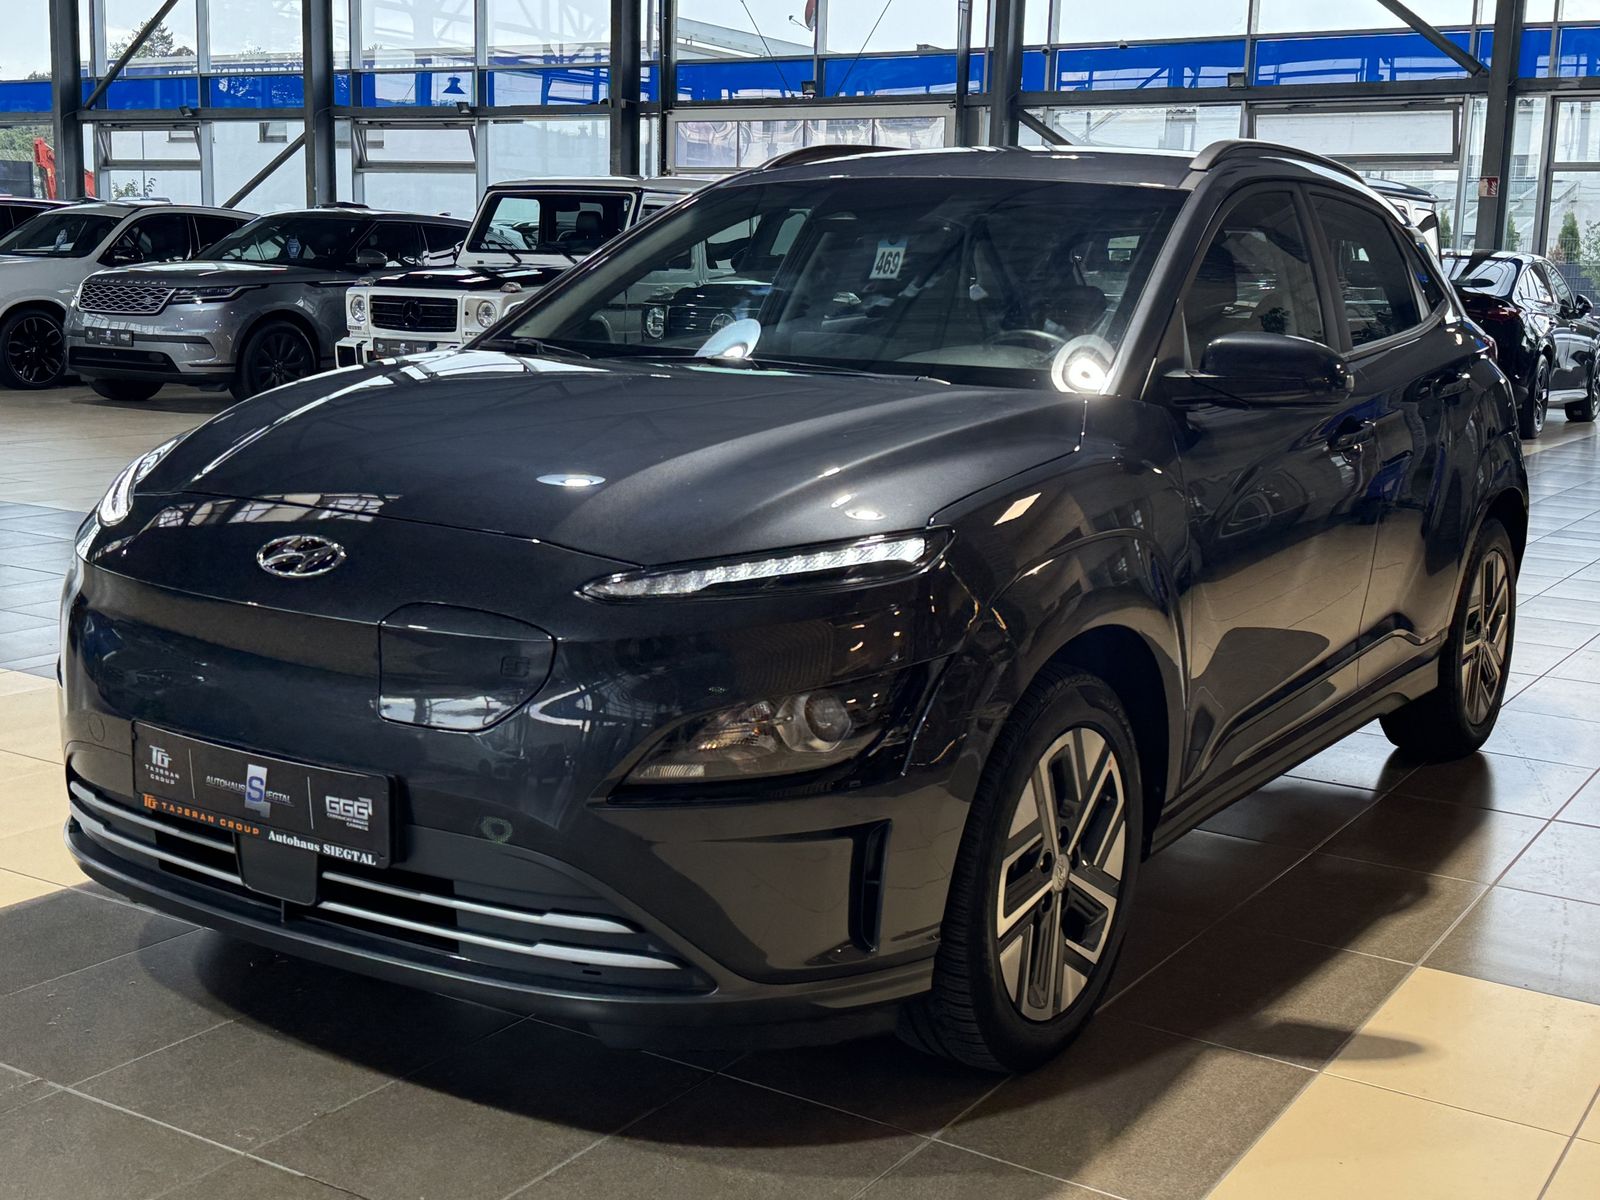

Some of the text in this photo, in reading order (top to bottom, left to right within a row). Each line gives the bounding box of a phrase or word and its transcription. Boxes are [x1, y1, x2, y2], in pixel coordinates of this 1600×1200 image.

[875, 251, 900, 275] 469
[205, 775, 246, 793] AUTOHAUS
[219, 817, 260, 836] GROUP
[268, 830, 377, 866] Autohaus SIEGTAL
